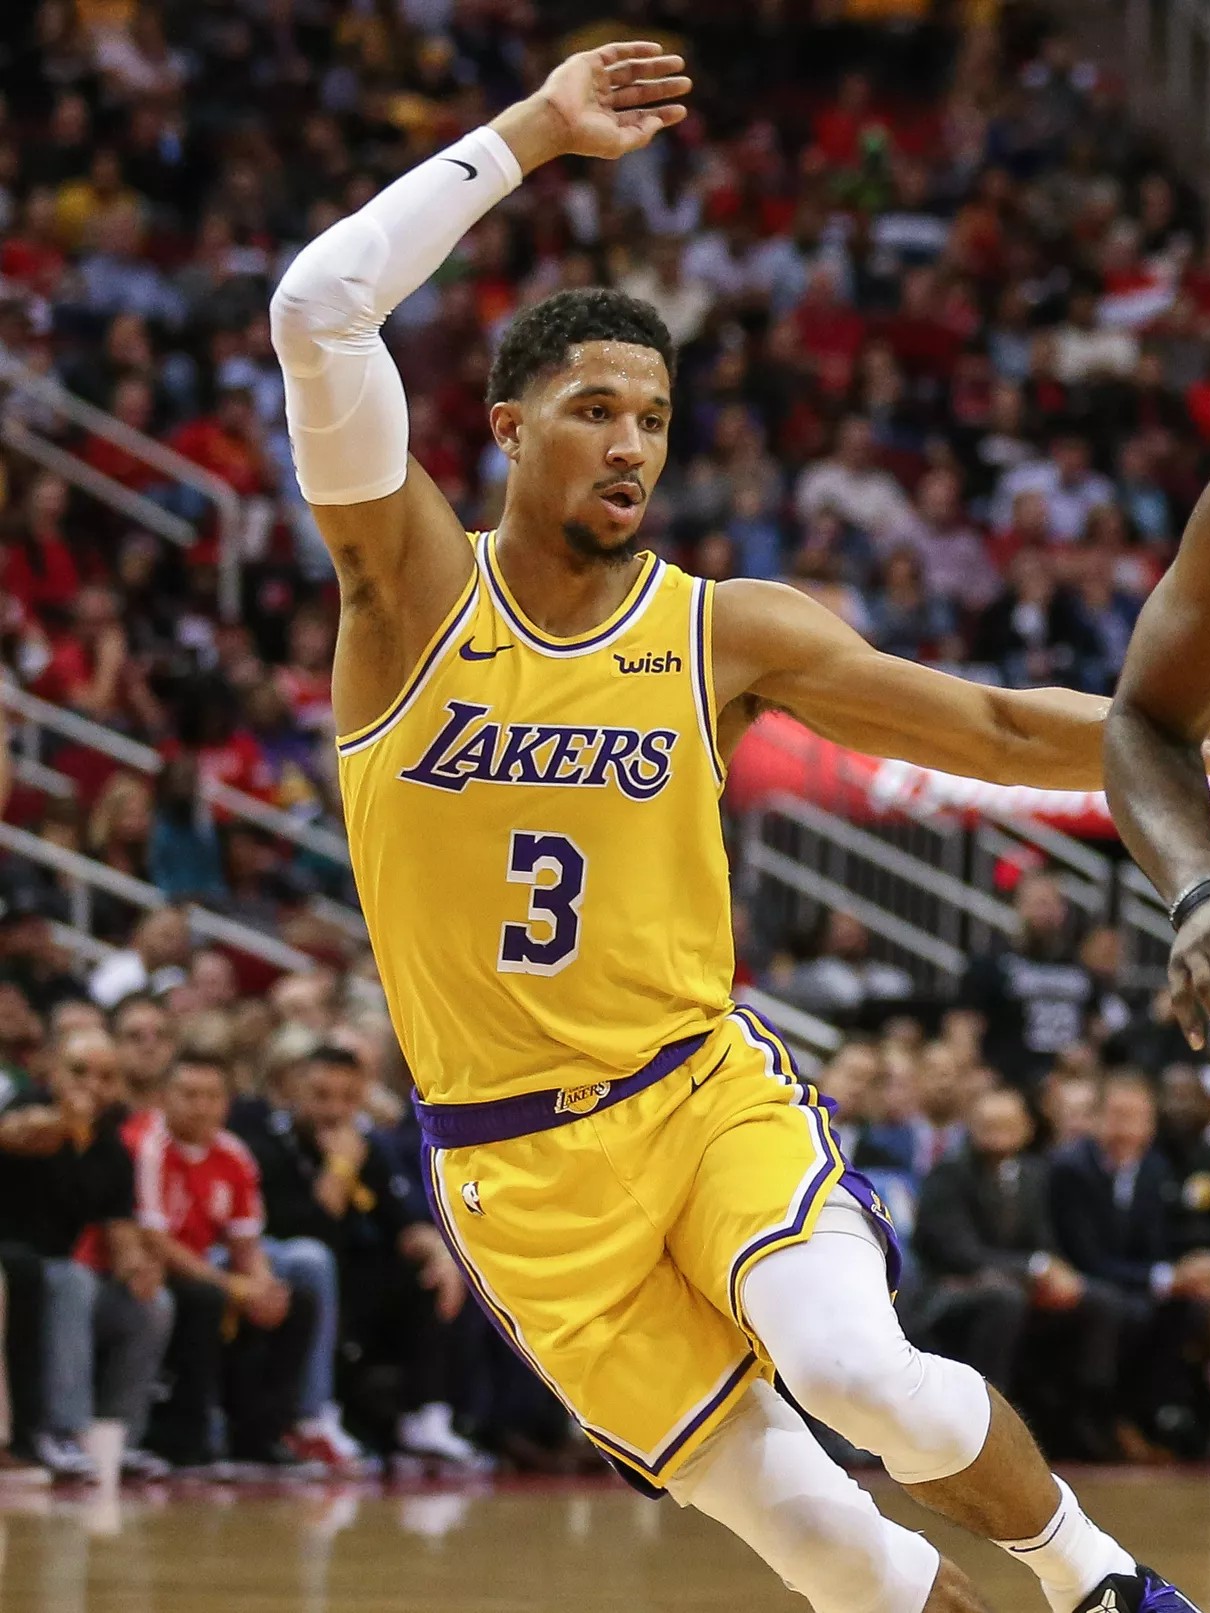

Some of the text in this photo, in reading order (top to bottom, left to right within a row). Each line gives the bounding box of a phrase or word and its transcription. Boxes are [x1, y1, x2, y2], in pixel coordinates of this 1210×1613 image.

[613, 650, 682, 674] wish
[397, 699, 680, 802] LAKERS
[497, 829, 589, 977] 3
[556, 1080, 611, 1112] LAKERS
